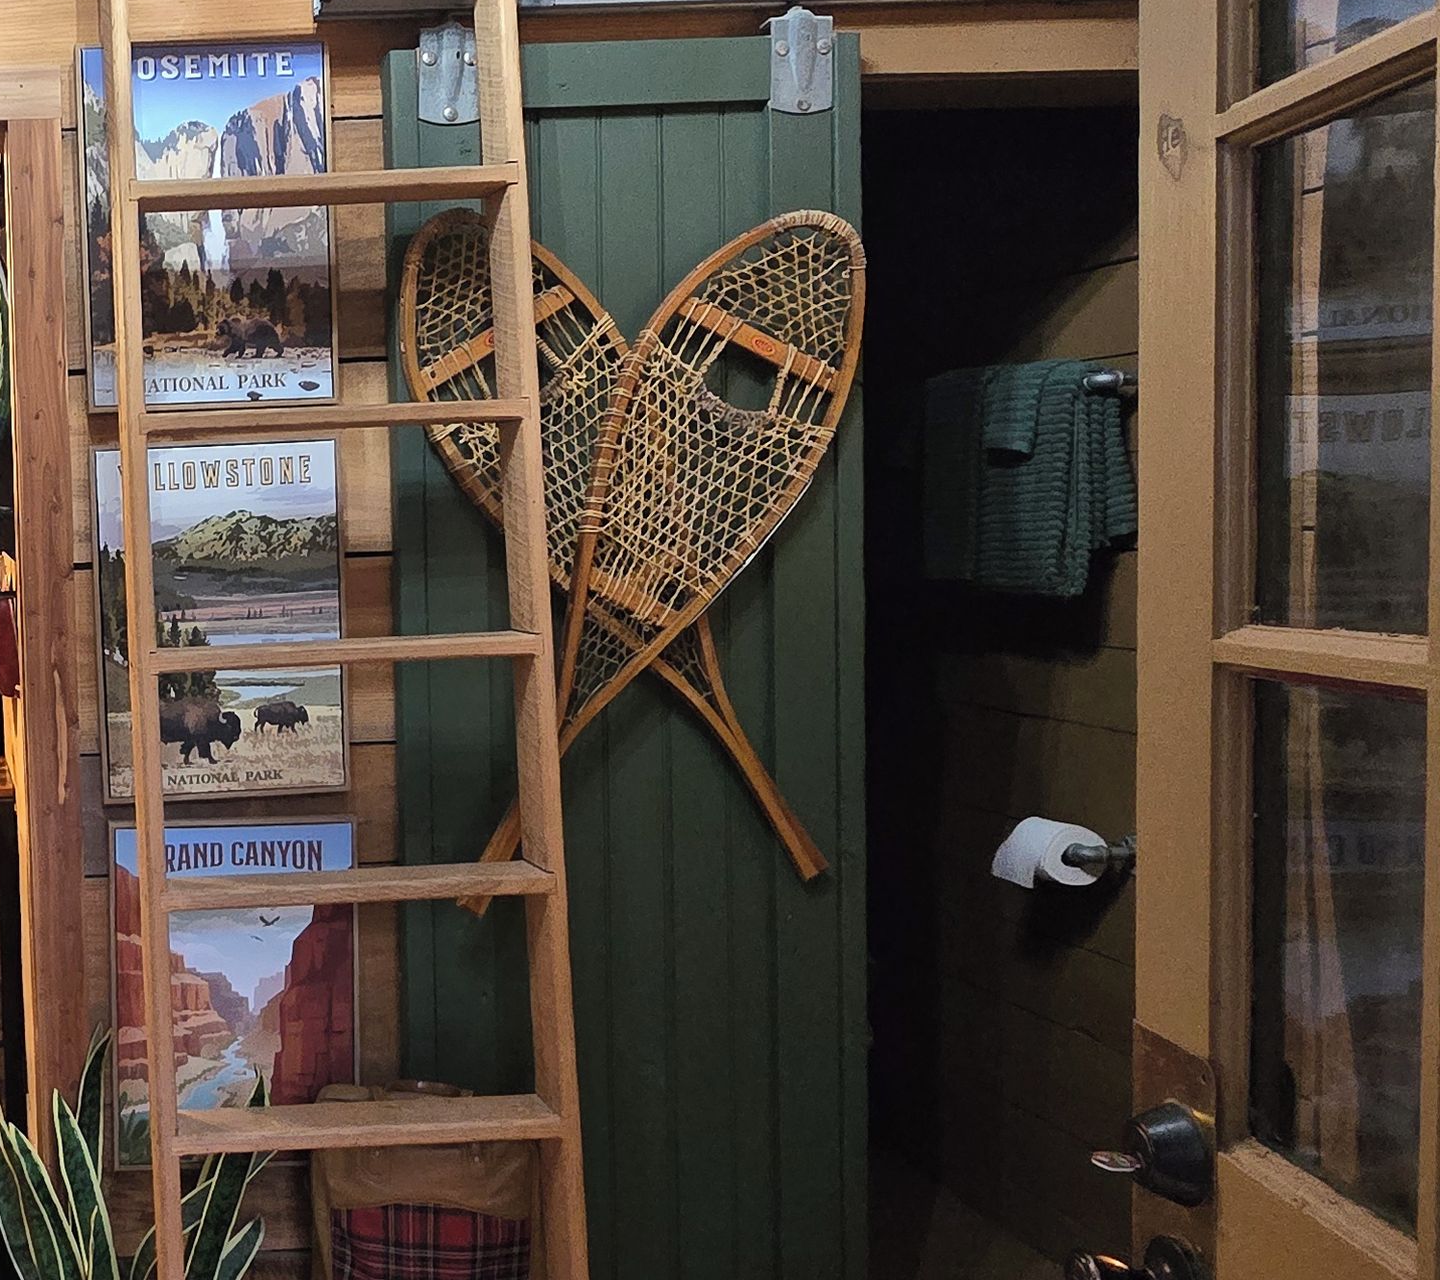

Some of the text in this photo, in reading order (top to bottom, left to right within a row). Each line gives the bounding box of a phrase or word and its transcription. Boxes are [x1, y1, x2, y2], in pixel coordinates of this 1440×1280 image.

[136, 51, 295, 81] OSEMITE
[237, 371, 288, 391] PARK
[118, 454, 312, 492] LLOWSTONE
[166, 768, 285, 787] NATIONAL PARK
[165, 838, 324, 874] RAND CANYON
